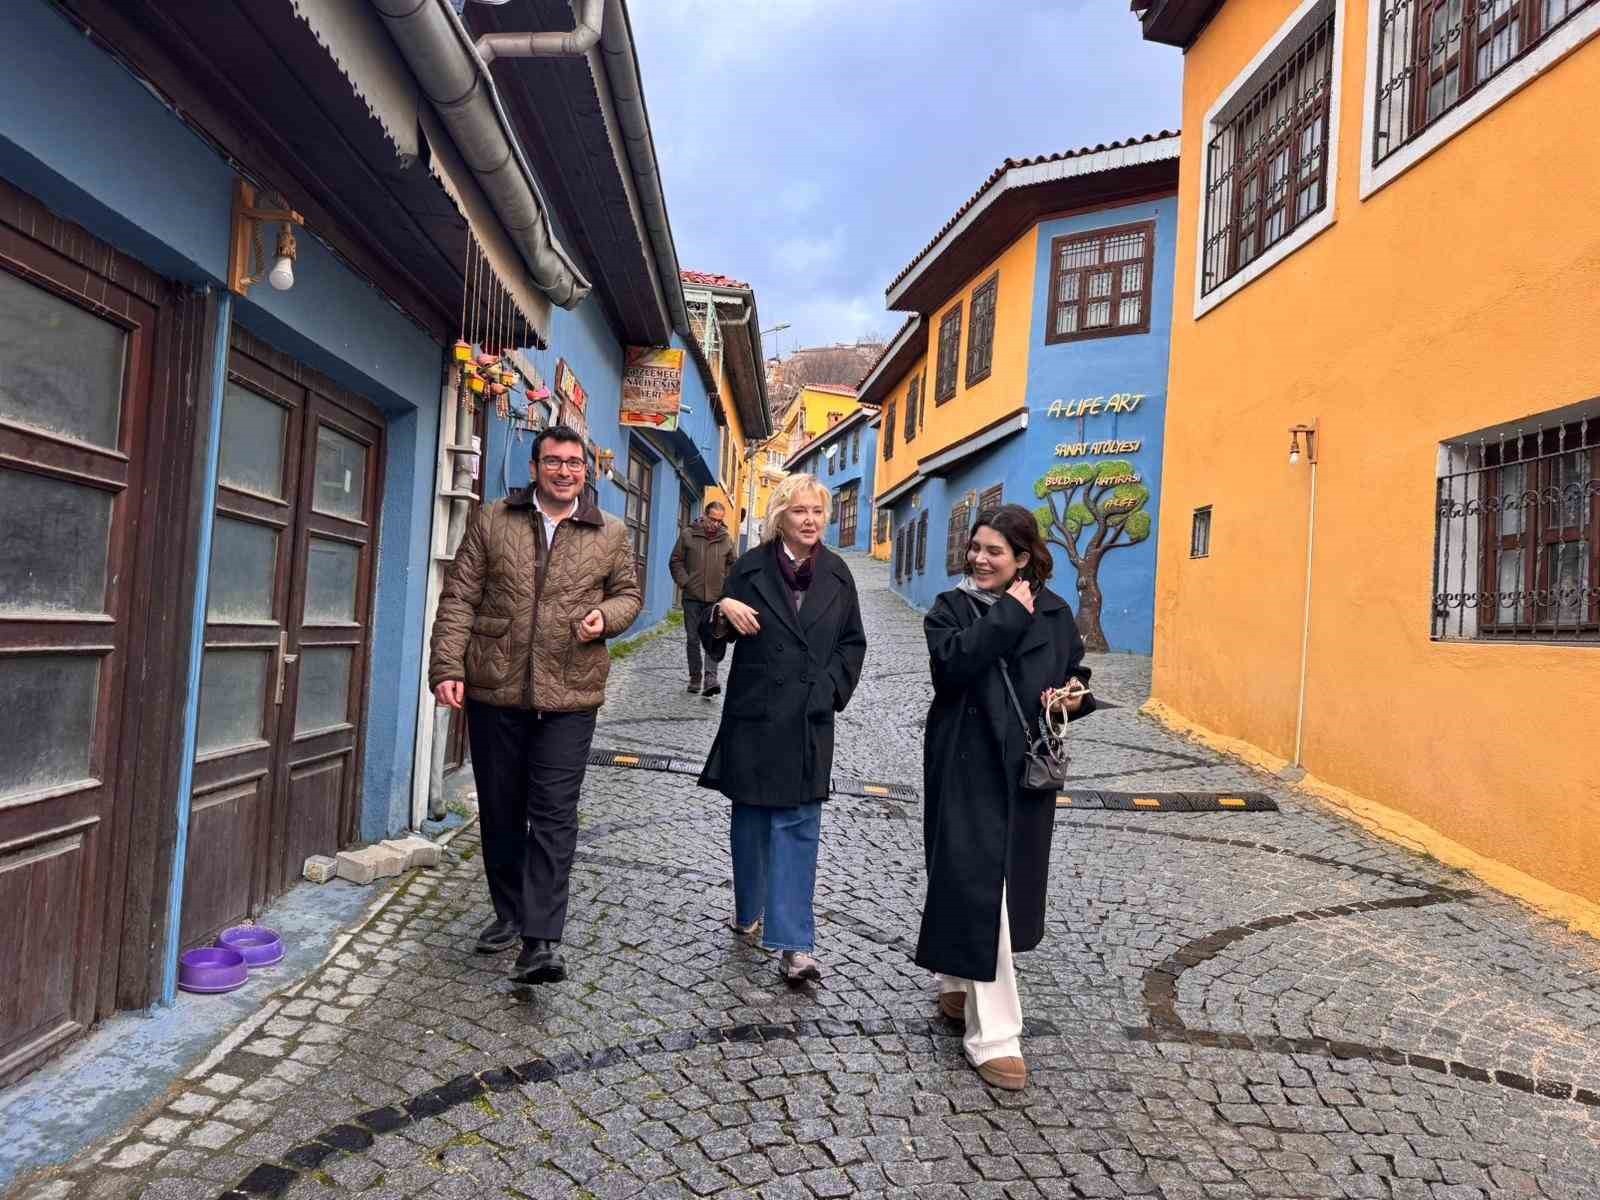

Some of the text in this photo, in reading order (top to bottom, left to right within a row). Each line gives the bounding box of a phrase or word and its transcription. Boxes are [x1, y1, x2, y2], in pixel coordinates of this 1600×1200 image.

[1047, 393, 1146, 418] A-LIFE ART
[1054, 442, 1088, 458] SANAT
